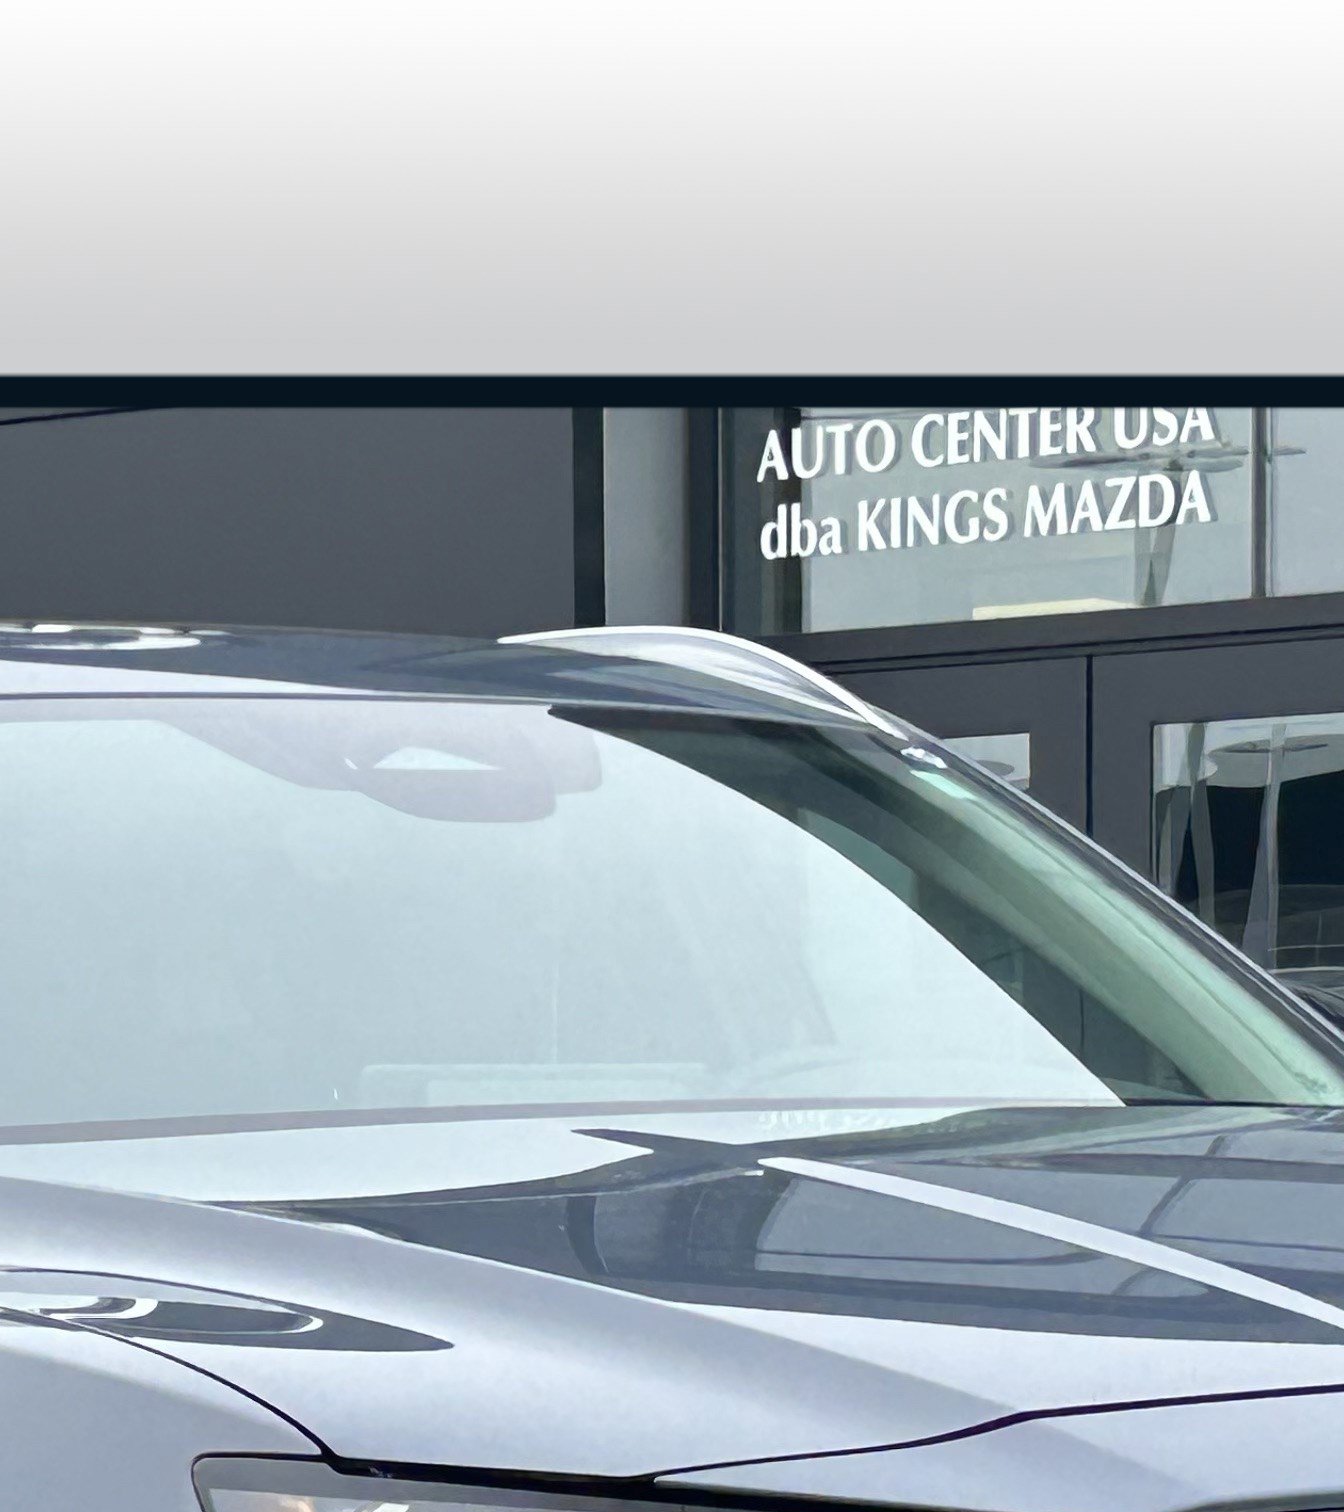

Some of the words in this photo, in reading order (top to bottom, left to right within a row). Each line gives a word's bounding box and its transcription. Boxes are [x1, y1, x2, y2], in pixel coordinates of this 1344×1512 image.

[757, 418, 896, 482] AUTO
[911, 407, 1096, 468] CENTER
[1112, 407, 1215, 449] USA
[760, 503, 842, 560] dba
[857, 488, 1008, 551] KINGS
[1024, 470, 1213, 538] MAZDA
